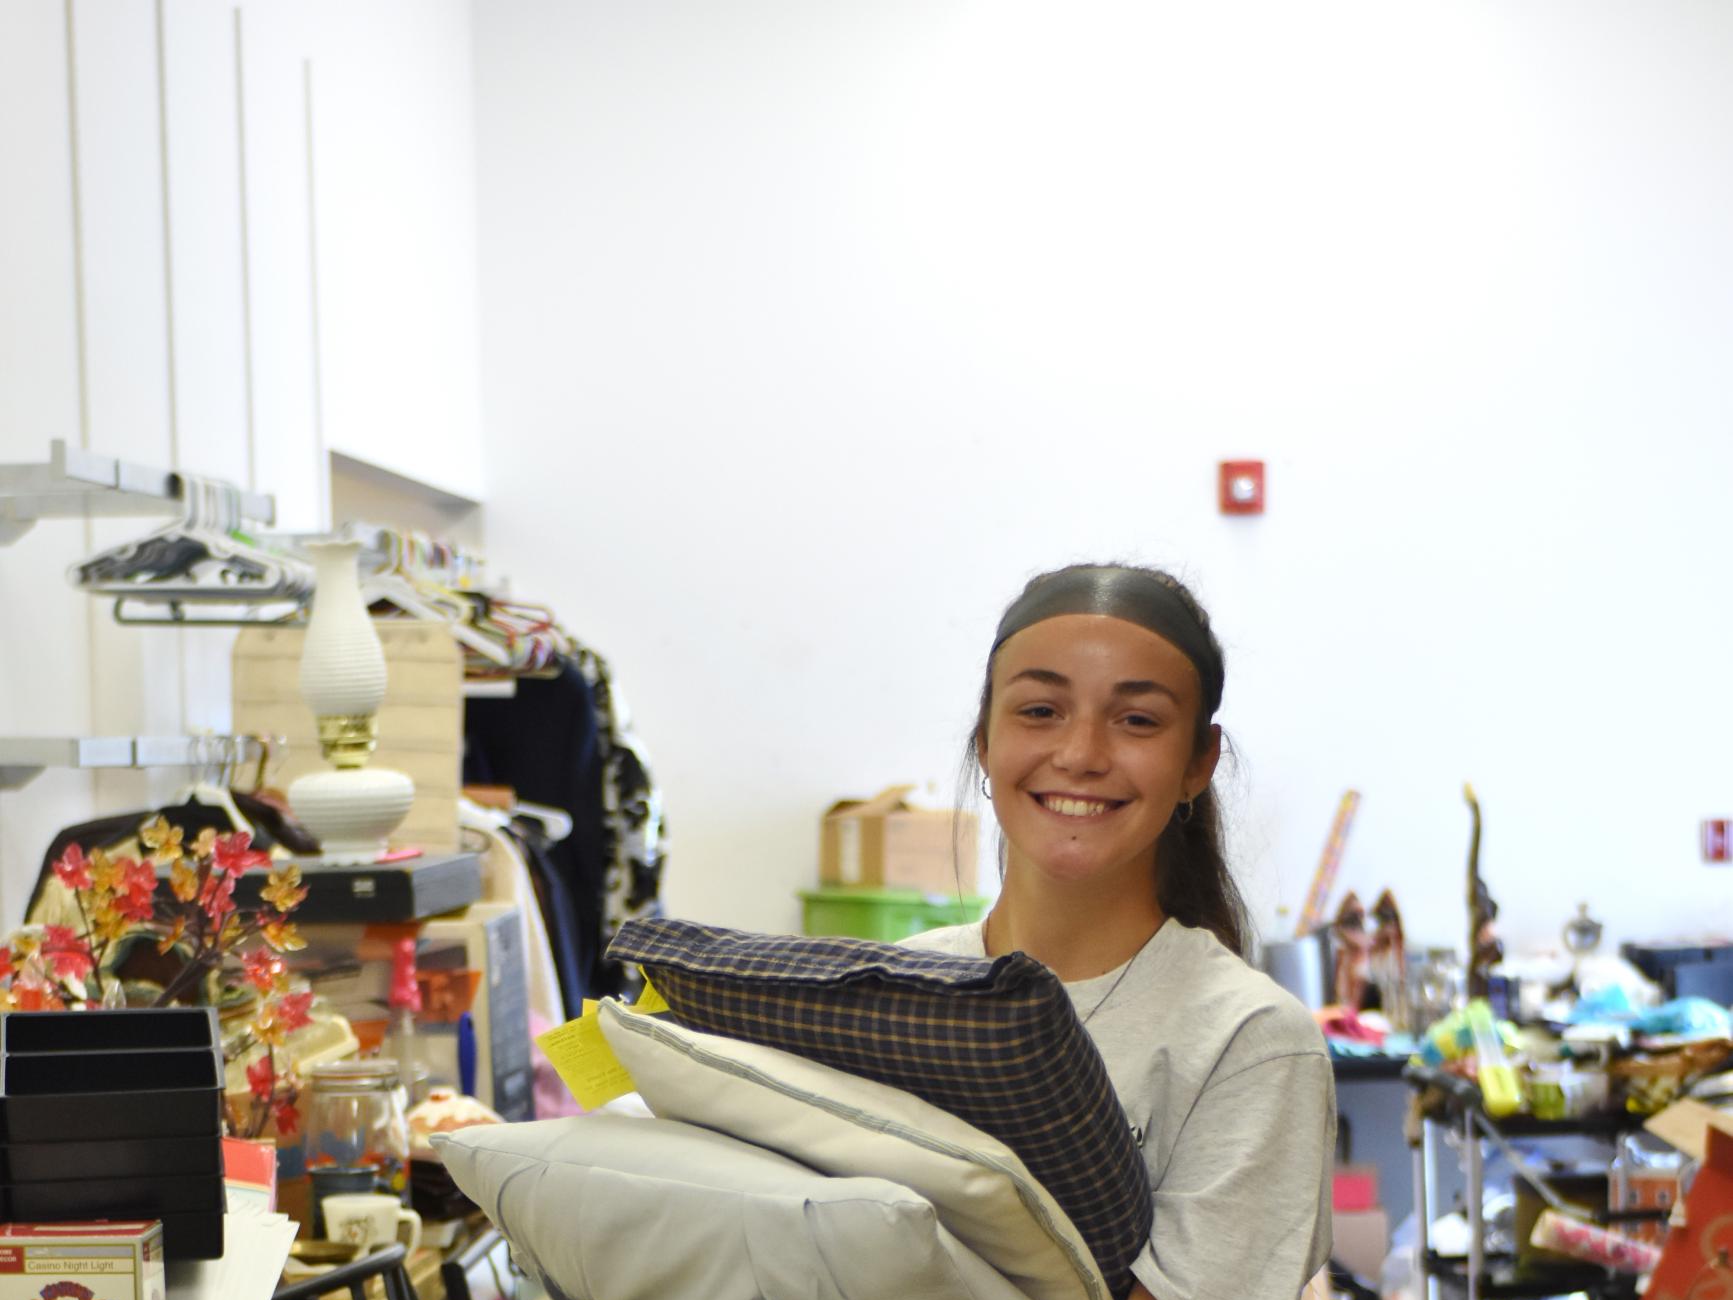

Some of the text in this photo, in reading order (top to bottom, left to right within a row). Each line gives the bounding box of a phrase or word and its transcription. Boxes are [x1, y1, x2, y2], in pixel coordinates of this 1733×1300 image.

[27, 1261, 114, 1272] Casino Night Light
